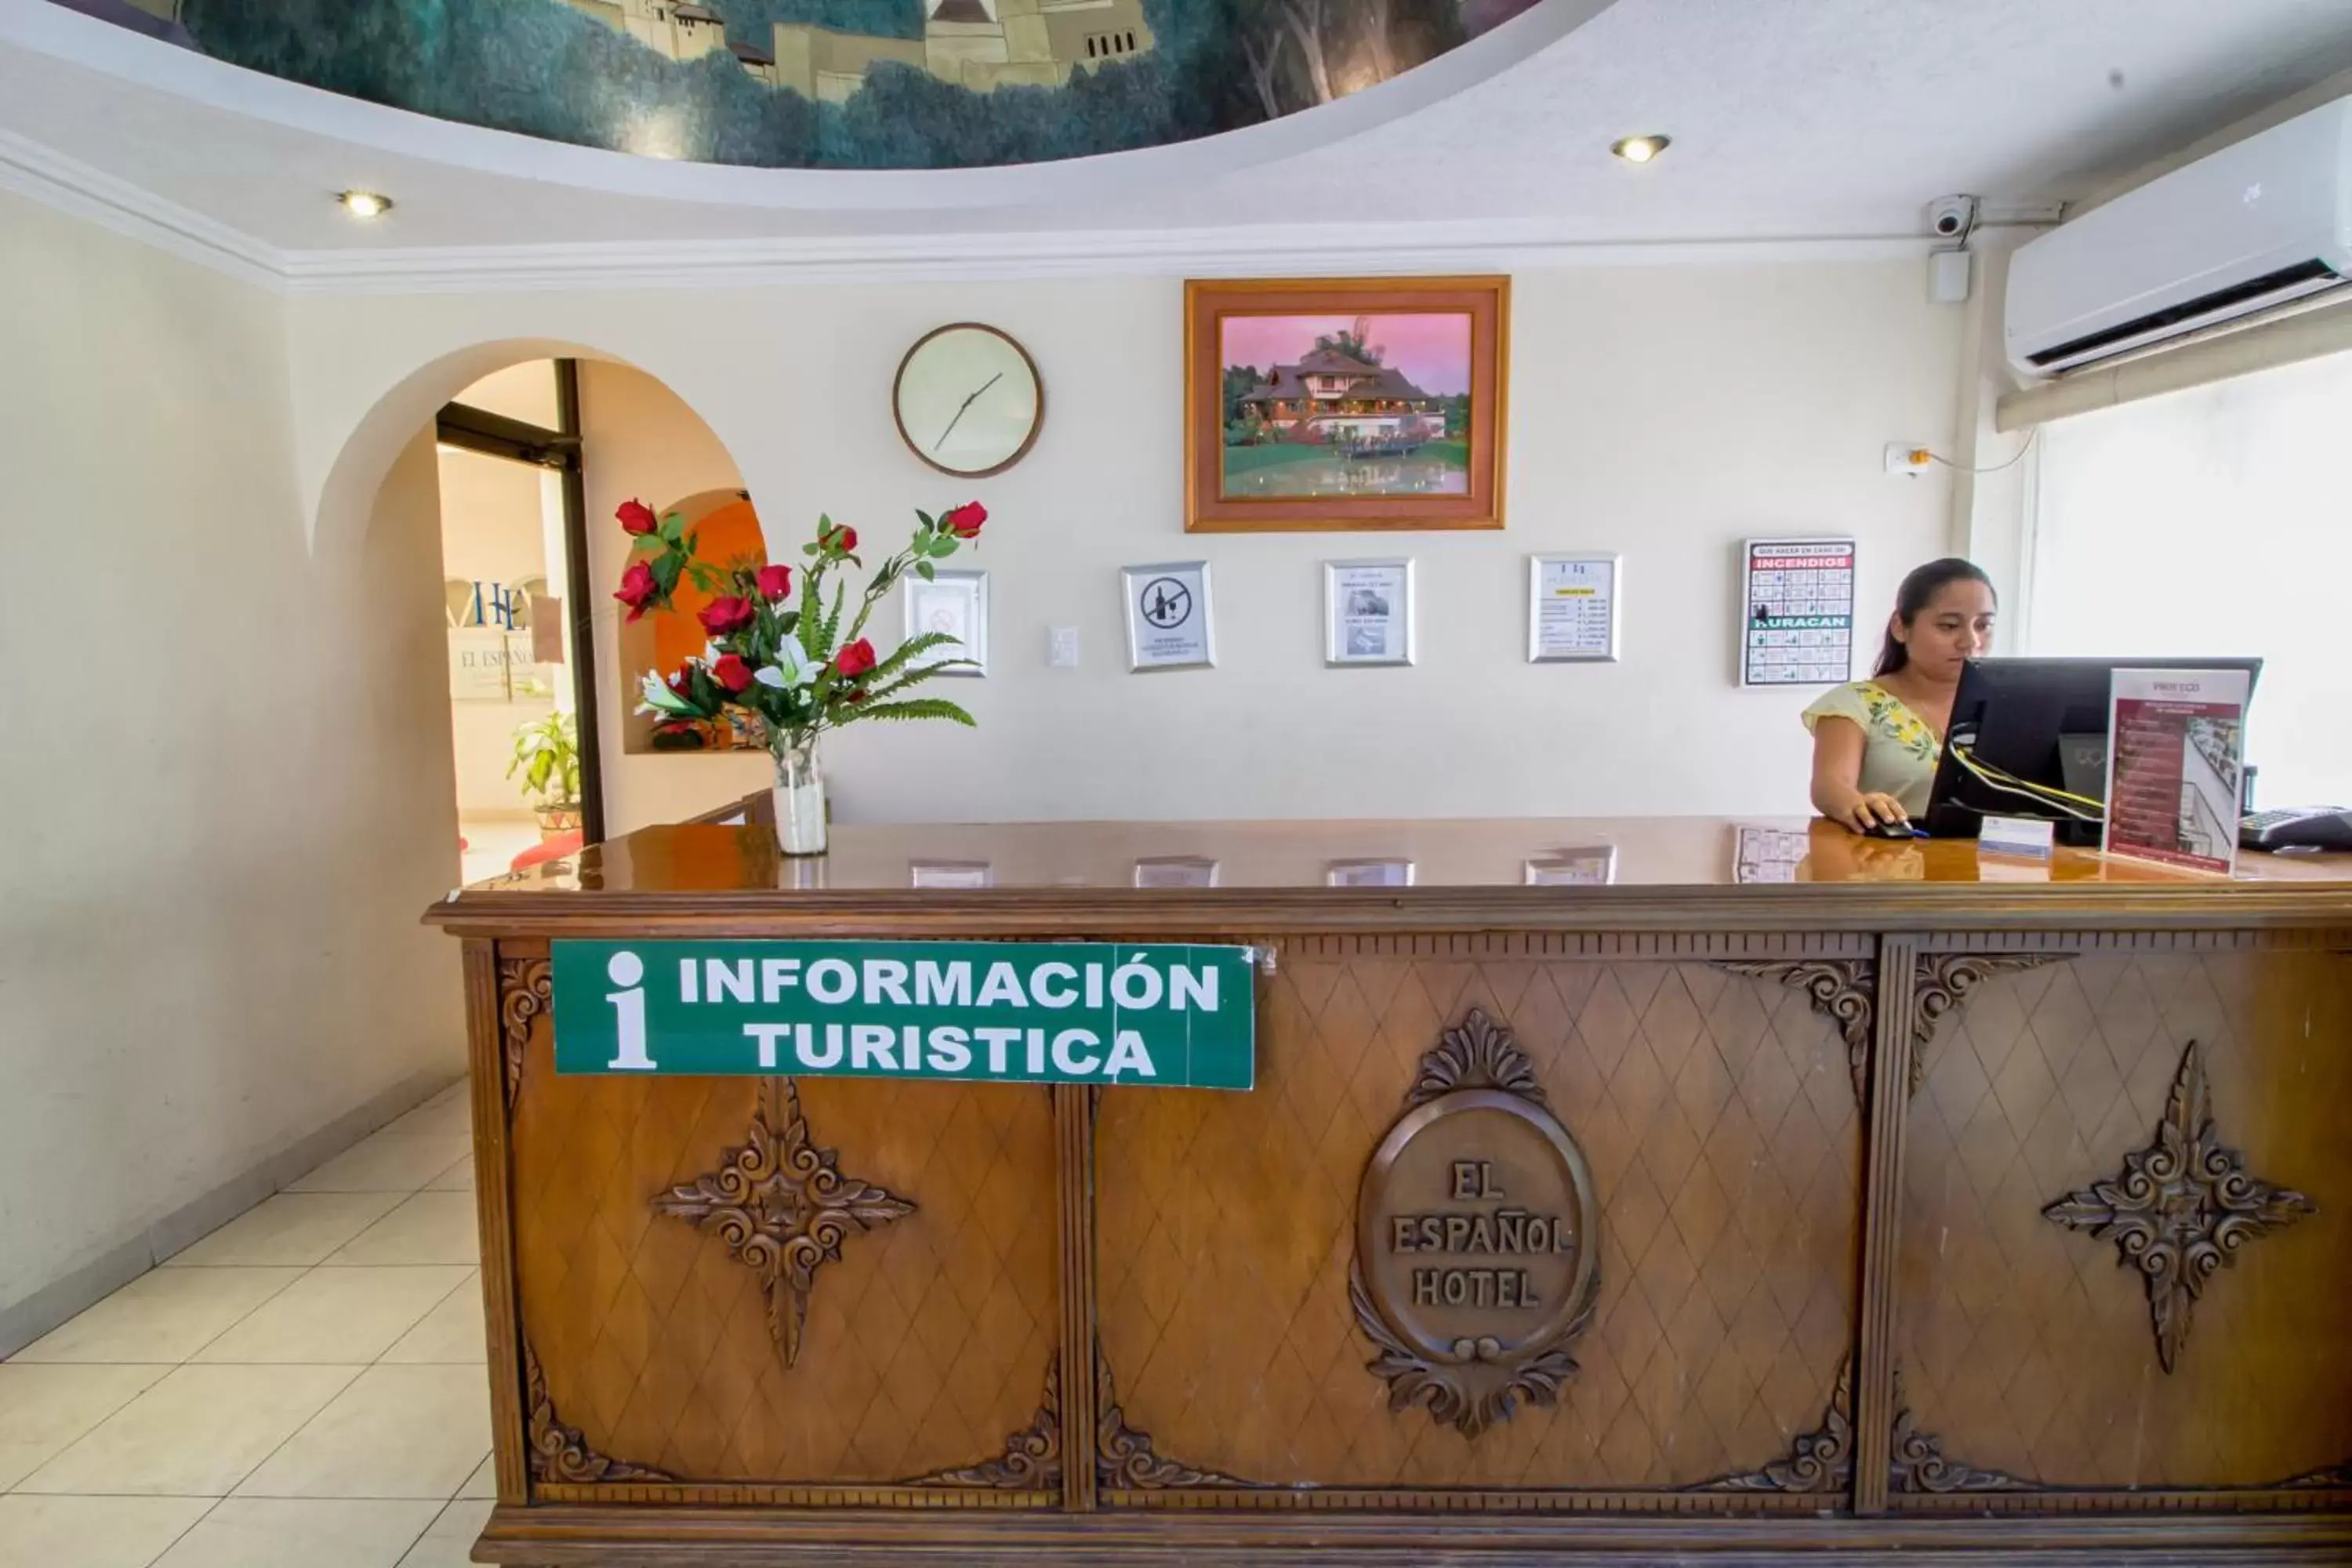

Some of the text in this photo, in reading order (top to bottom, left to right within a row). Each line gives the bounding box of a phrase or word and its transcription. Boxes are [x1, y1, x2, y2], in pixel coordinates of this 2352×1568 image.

[1756, 557, 1847, 568] INCENDIOS
[679, 952, 1218, 1011] INFORMACIÓN
[742, 1023, 1156, 1076] TURISTICA
[1453, 1161, 1504, 1200] EL
[1392, 1210, 1573, 1254] ESPAÑOL
[1414, 1269, 1539, 1308] HOTEL
